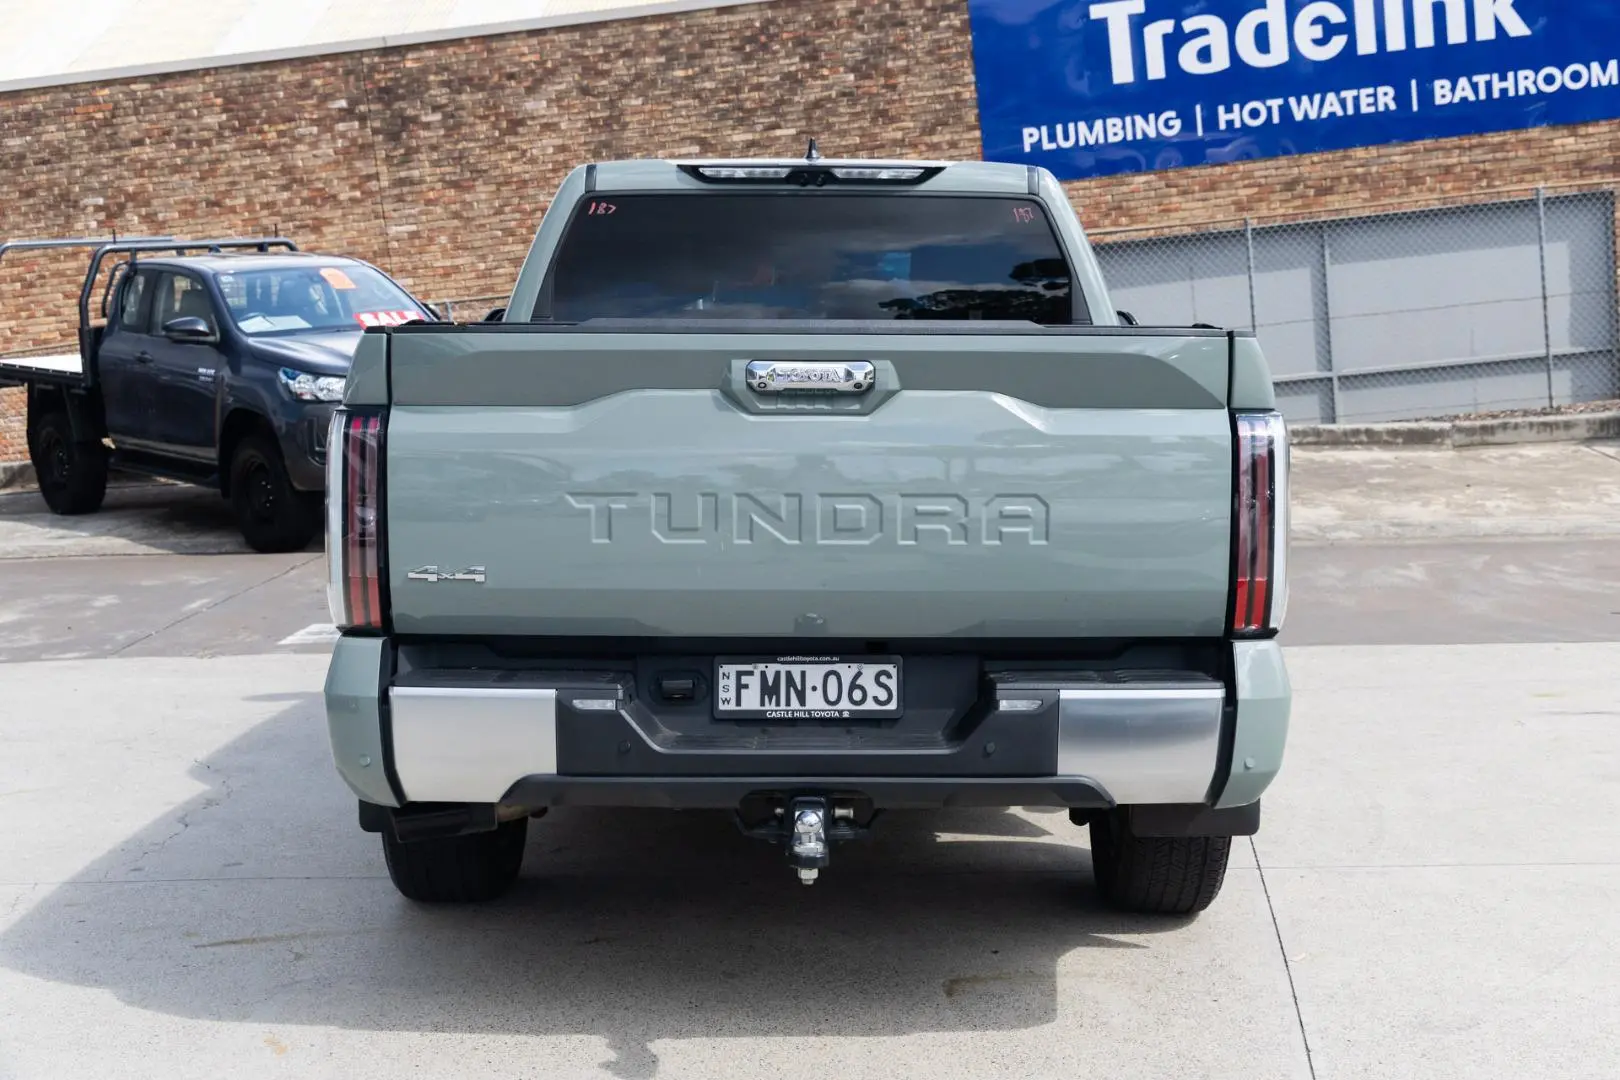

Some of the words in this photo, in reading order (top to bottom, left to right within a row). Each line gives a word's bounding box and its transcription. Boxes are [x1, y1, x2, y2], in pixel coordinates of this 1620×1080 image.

[1088, 0, 1533, 85] Tradelink
[1022, 109, 1182, 153] PLUMBING
[1217, 97, 1284, 131] HOT
[1288, 85, 1397, 122] WATER
[1433, 58, 1619, 106] BATHROOM
[588, 201, 617, 215] 187
[779, 367, 842, 383] TOYOTA
[565, 491, 1051, 546] TUNDRA
[407, 565, 486, 582] 4x4
[766, 710, 793, 718] CASTLE
[794, 710, 810, 718] HILL
[811, 710, 840, 718] TOYOTA
